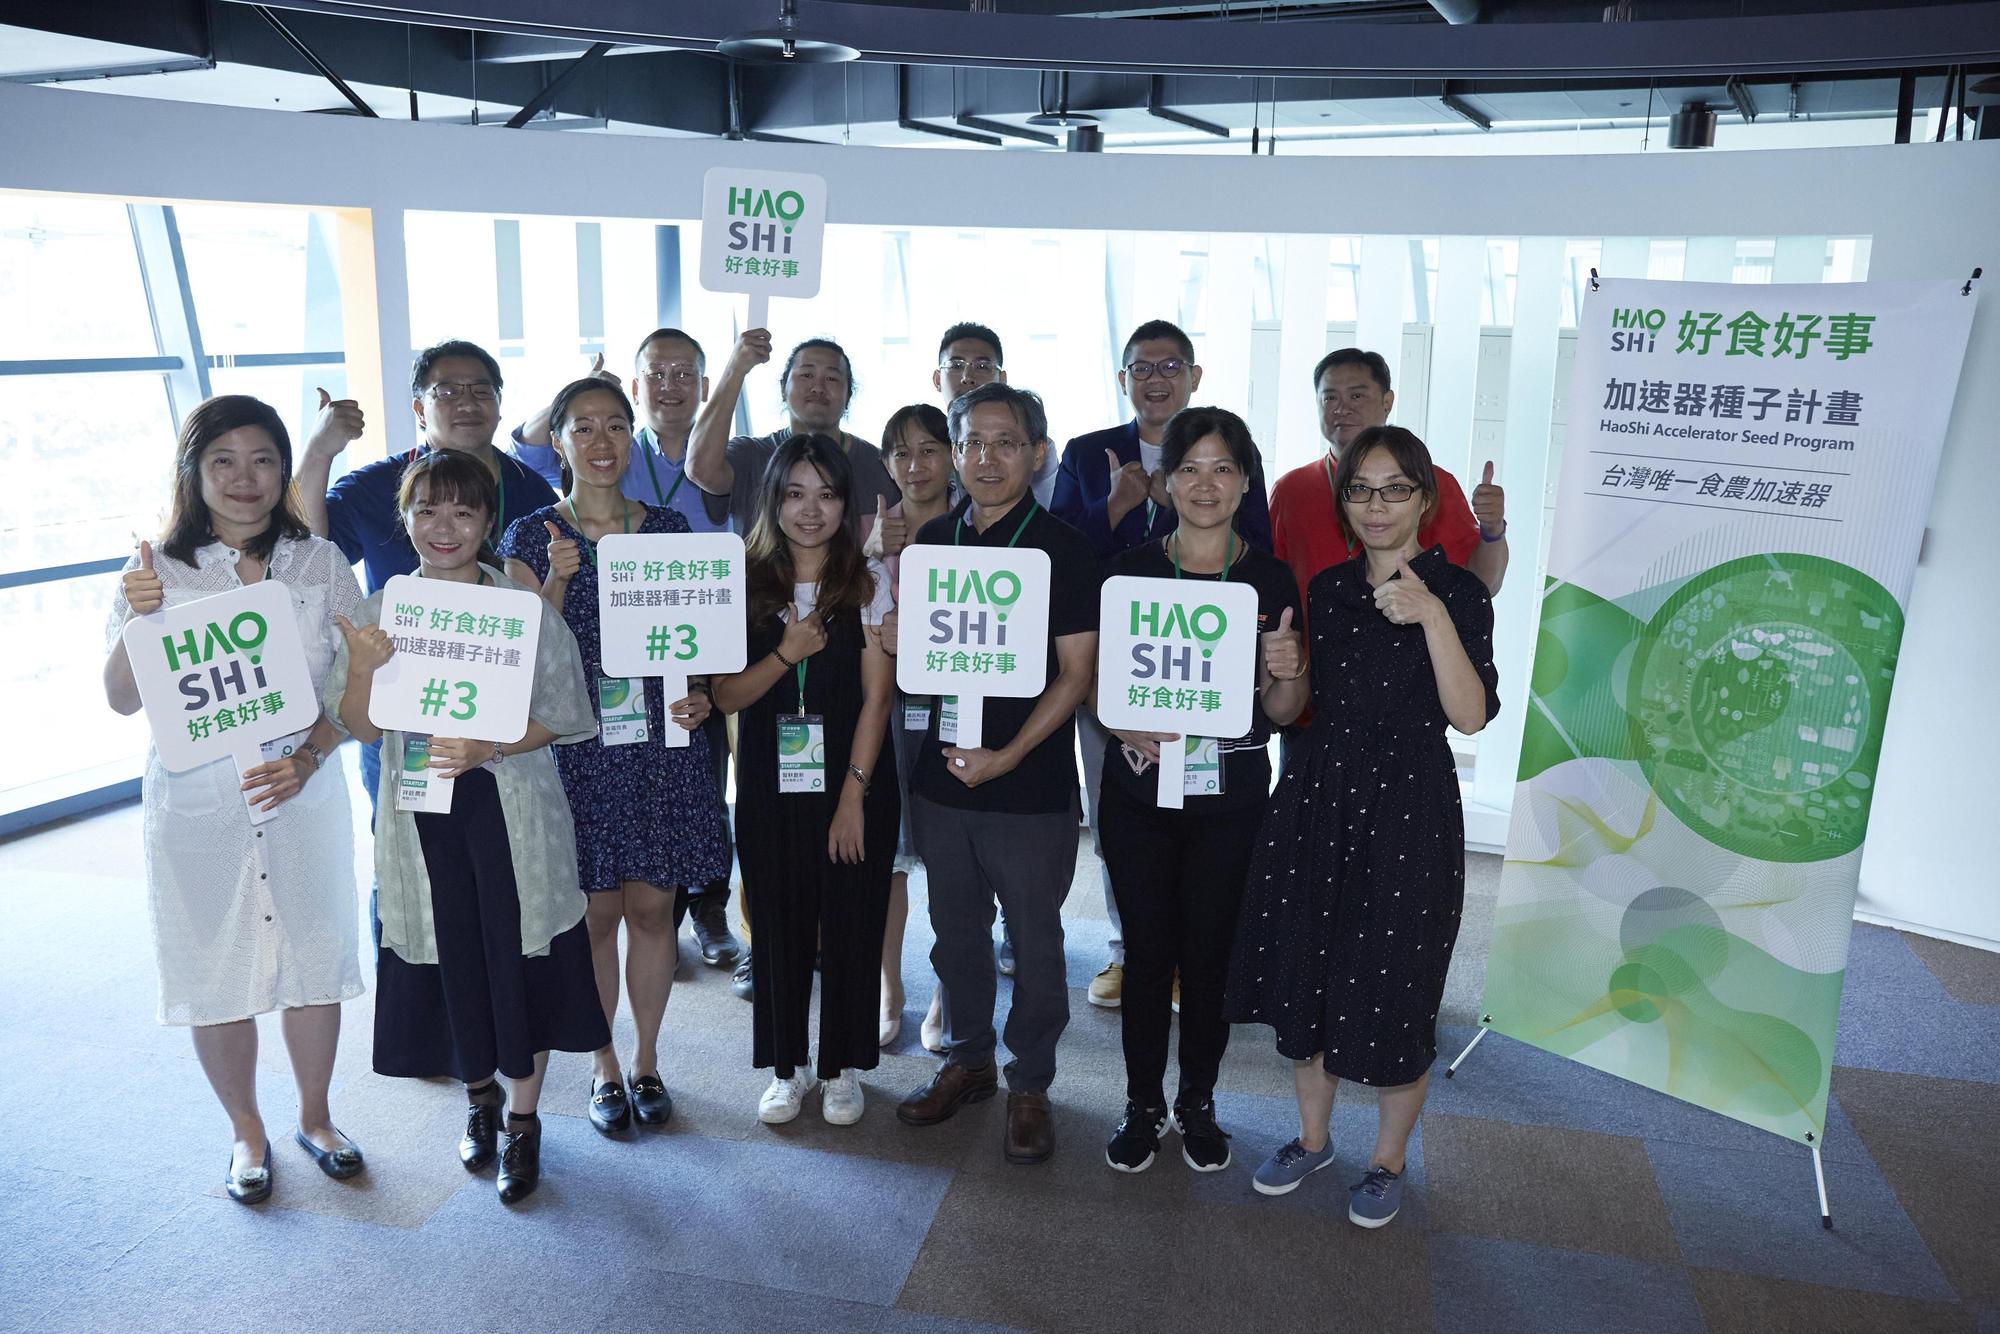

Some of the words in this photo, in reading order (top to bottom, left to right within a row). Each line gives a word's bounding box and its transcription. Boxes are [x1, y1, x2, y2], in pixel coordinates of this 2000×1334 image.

[728, 187, 805, 220] HAO
[725, 255, 799, 278] 好食好事
[1612, 308, 1666, 329] HAO
[1675, 309, 1877, 361] 好食好事
[1603, 378, 1863, 427] 加速器種子計畫
[1600, 418, 1650, 436] HaoShi
[1653, 423, 1738, 443] Accelerator
[1741, 429, 1779, 446] Seed
[1783, 432, 1855, 453] Program
[1601, 463, 1833, 510] 台灣唯一食農加速器
[610, 561, 637, 571] HAO
[643, 559, 731, 581] 好食好事
[610, 588, 732, 607] 加速器種子計畫
[928, 568, 1022, 606] HAO
[395, 603, 424, 617] HAO
[429, 608, 526, 640] 好食好事
[1130, 600, 1228, 642] HAO
[162, 611, 268, 672] HAO
[388, 634, 521, 667] 加速器種子計畫
[645, 623, 699, 661] #3
[926, 650, 1017, 674] 好食好事
[419, 678, 478, 721] #3
[1128, 684, 1222, 712] 好食好事
[187, 690, 286, 742] 好食好事
